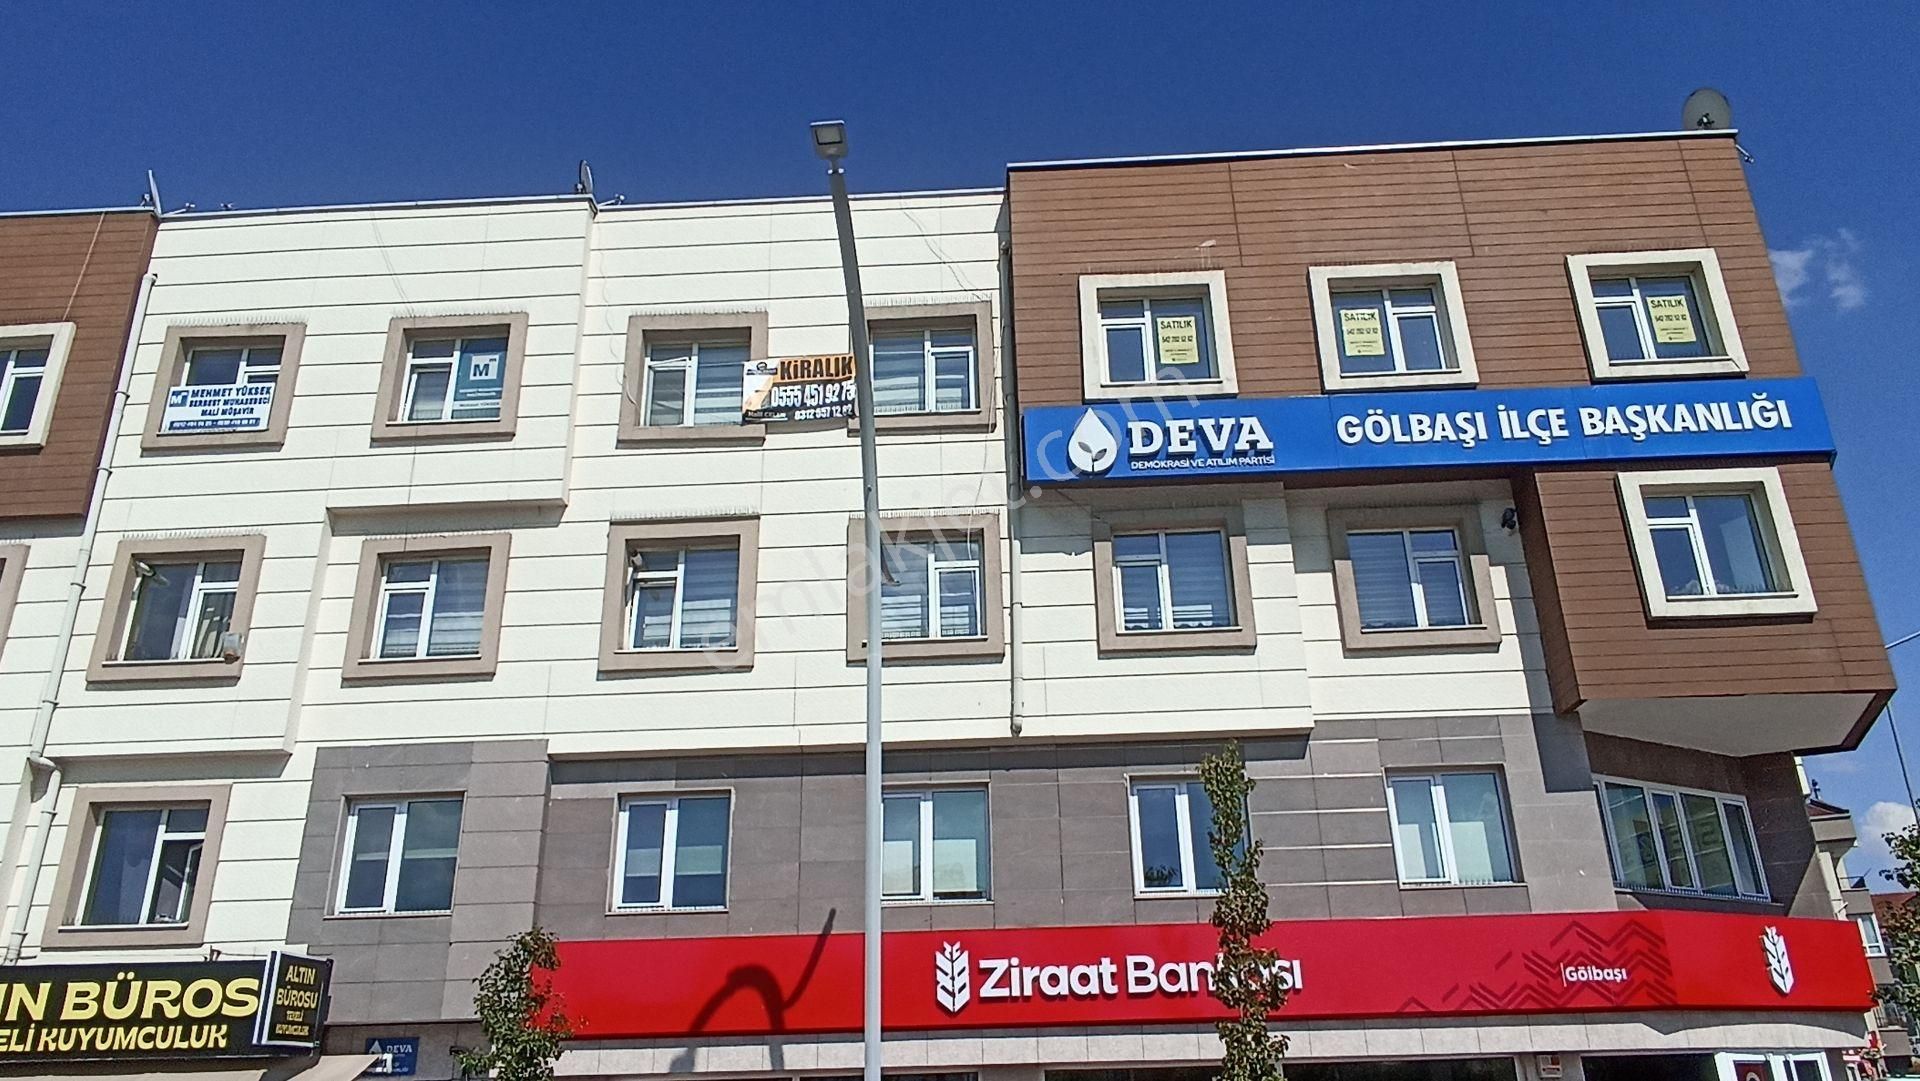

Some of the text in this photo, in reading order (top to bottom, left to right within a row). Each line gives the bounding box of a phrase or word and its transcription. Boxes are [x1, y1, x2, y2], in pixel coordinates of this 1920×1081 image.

[1650, 299, 1684, 308] SATILIK
[1160, 320, 1192, 329] SATILIK
[1344, 312, 1377, 321] SATILIK
[190, 385, 272, 398] MEHMET YÜKSEK
[771, 385, 802, 407] 0555
[803, 384, 824, 407] 451
[825, 383, 840, 404] 92
[189, 399, 220, 407] SERBEST
[201, 407, 220, 416] MALİ
[1336, 392, 1793, 448] GÖLBAŞI İLÇE BAŞKANLIĞI
[1128, 416, 1274, 454] DEVA
[1131, 454, 1275, 470] DEMOKRASİ VE ATILIM PARTİSİ
[285, 965, 316, 985] ALTIN
[979, 956, 1119, 998] Ziraat
[1565, 965, 1628, 983] Gölbaşı
[276, 985, 318, 1009] BÜROSU
[38, 1024, 228, 1051] KUYUMCULUK
